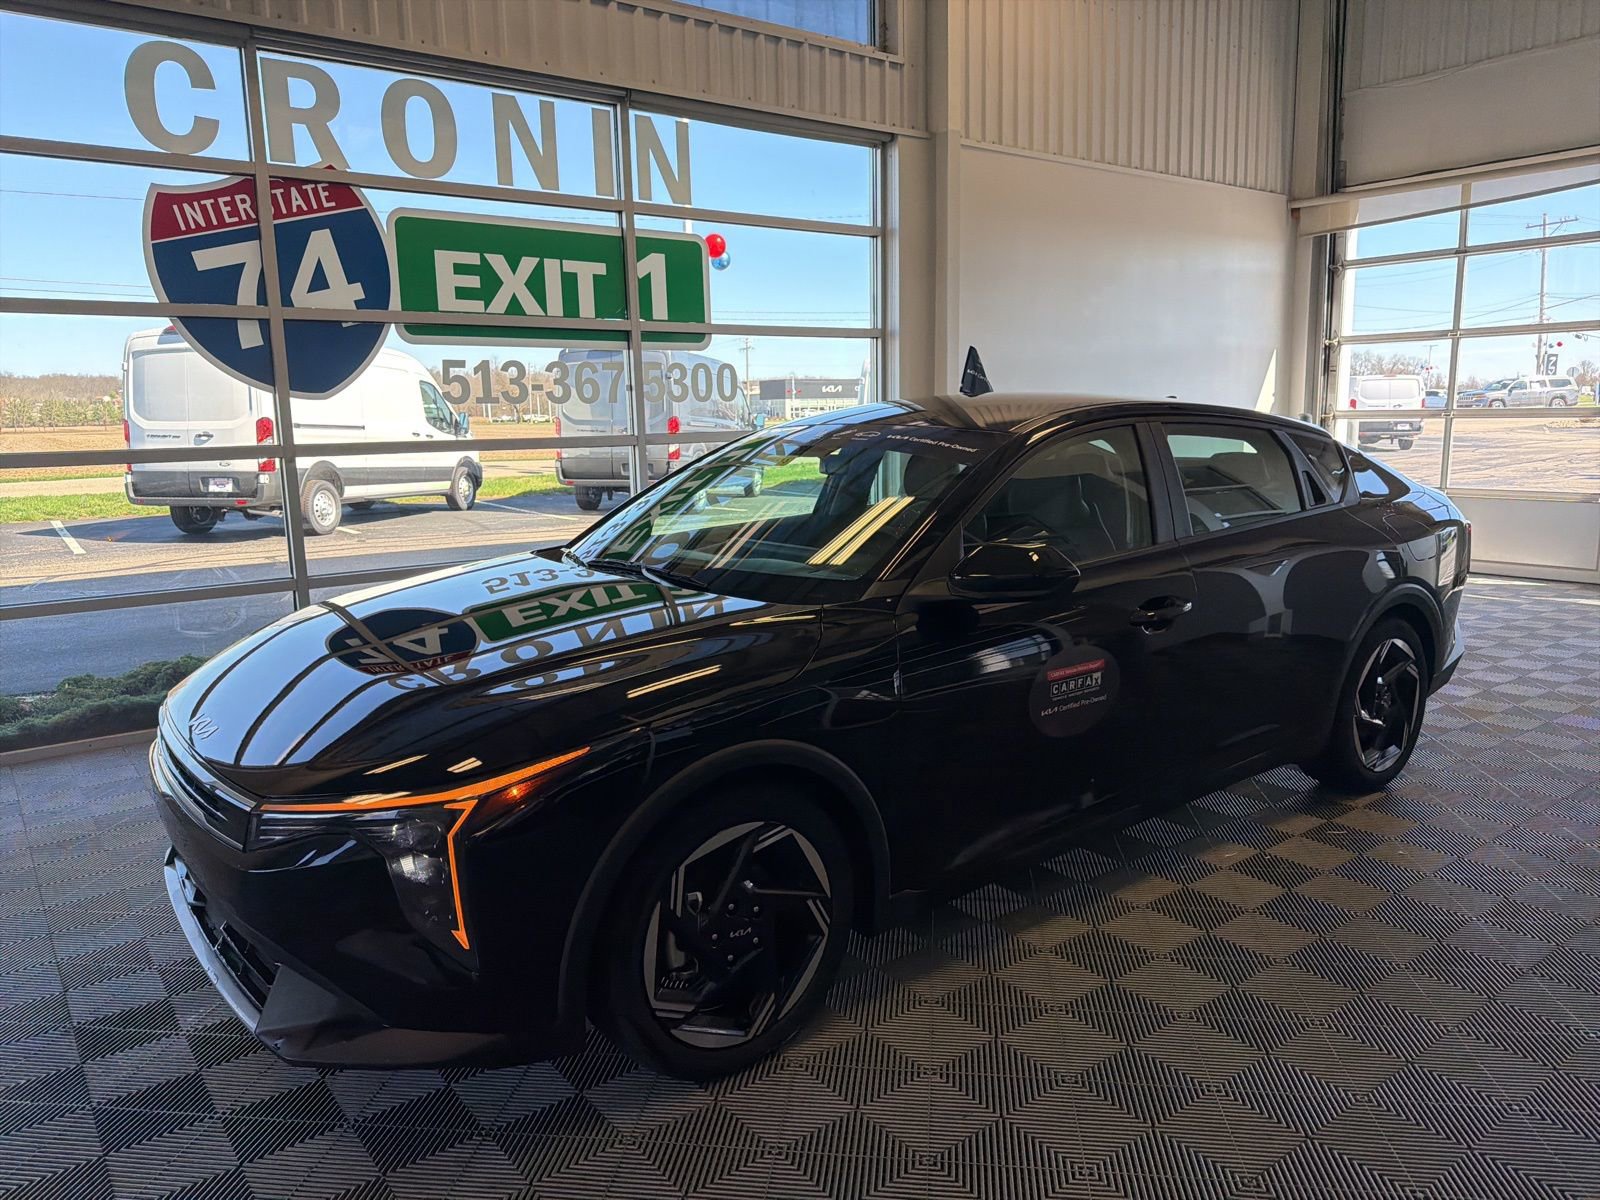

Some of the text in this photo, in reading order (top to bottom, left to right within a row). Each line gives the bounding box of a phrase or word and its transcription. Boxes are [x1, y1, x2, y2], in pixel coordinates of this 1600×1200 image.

[124, 40, 692, 205] CRONIN
[172, 183, 336, 231] INTERTATE
[191, 228, 366, 350] 74
[434, 249, 669, 321] EXIT 1
[821, 384, 843, 393] KIA
[1052, 672, 1101, 695] CARFAX
[1041, 706, 1059, 717] KIA
[1059, 698, 1081, 712] Certified
[1080, 694, 1107, 707] Pre-Owned
[188, 713, 220, 740] KIA
[730, 927, 752, 938] KIA
